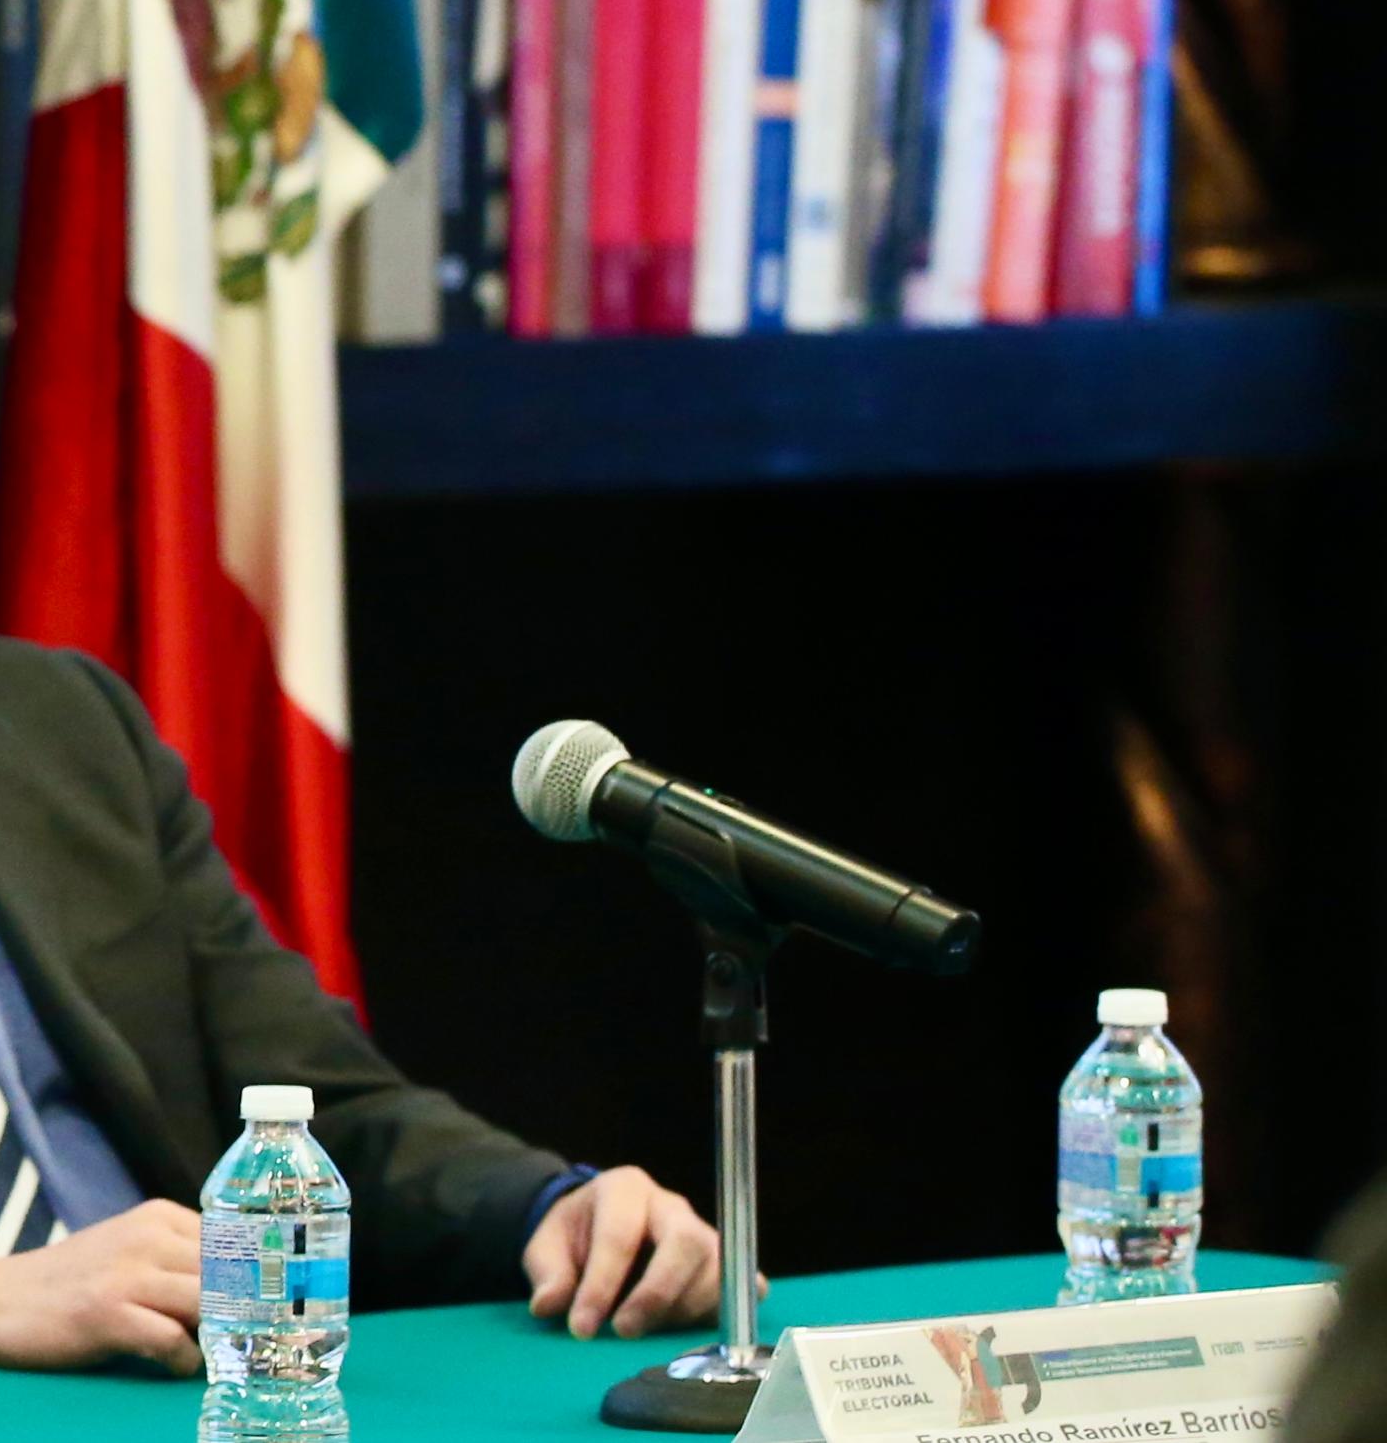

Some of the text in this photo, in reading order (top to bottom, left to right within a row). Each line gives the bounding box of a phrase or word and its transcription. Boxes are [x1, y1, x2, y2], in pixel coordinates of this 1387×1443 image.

[830, 1354, 904, 1372] CÁTEDRA
[836, 1373, 915, 1393] TRIBUNAL
[843, 1392, 934, 1412] ELECTORAL
[1060, 1418, 1175, 1442] Ramírez
[1181, 1407, 1284, 1433] Barrios
